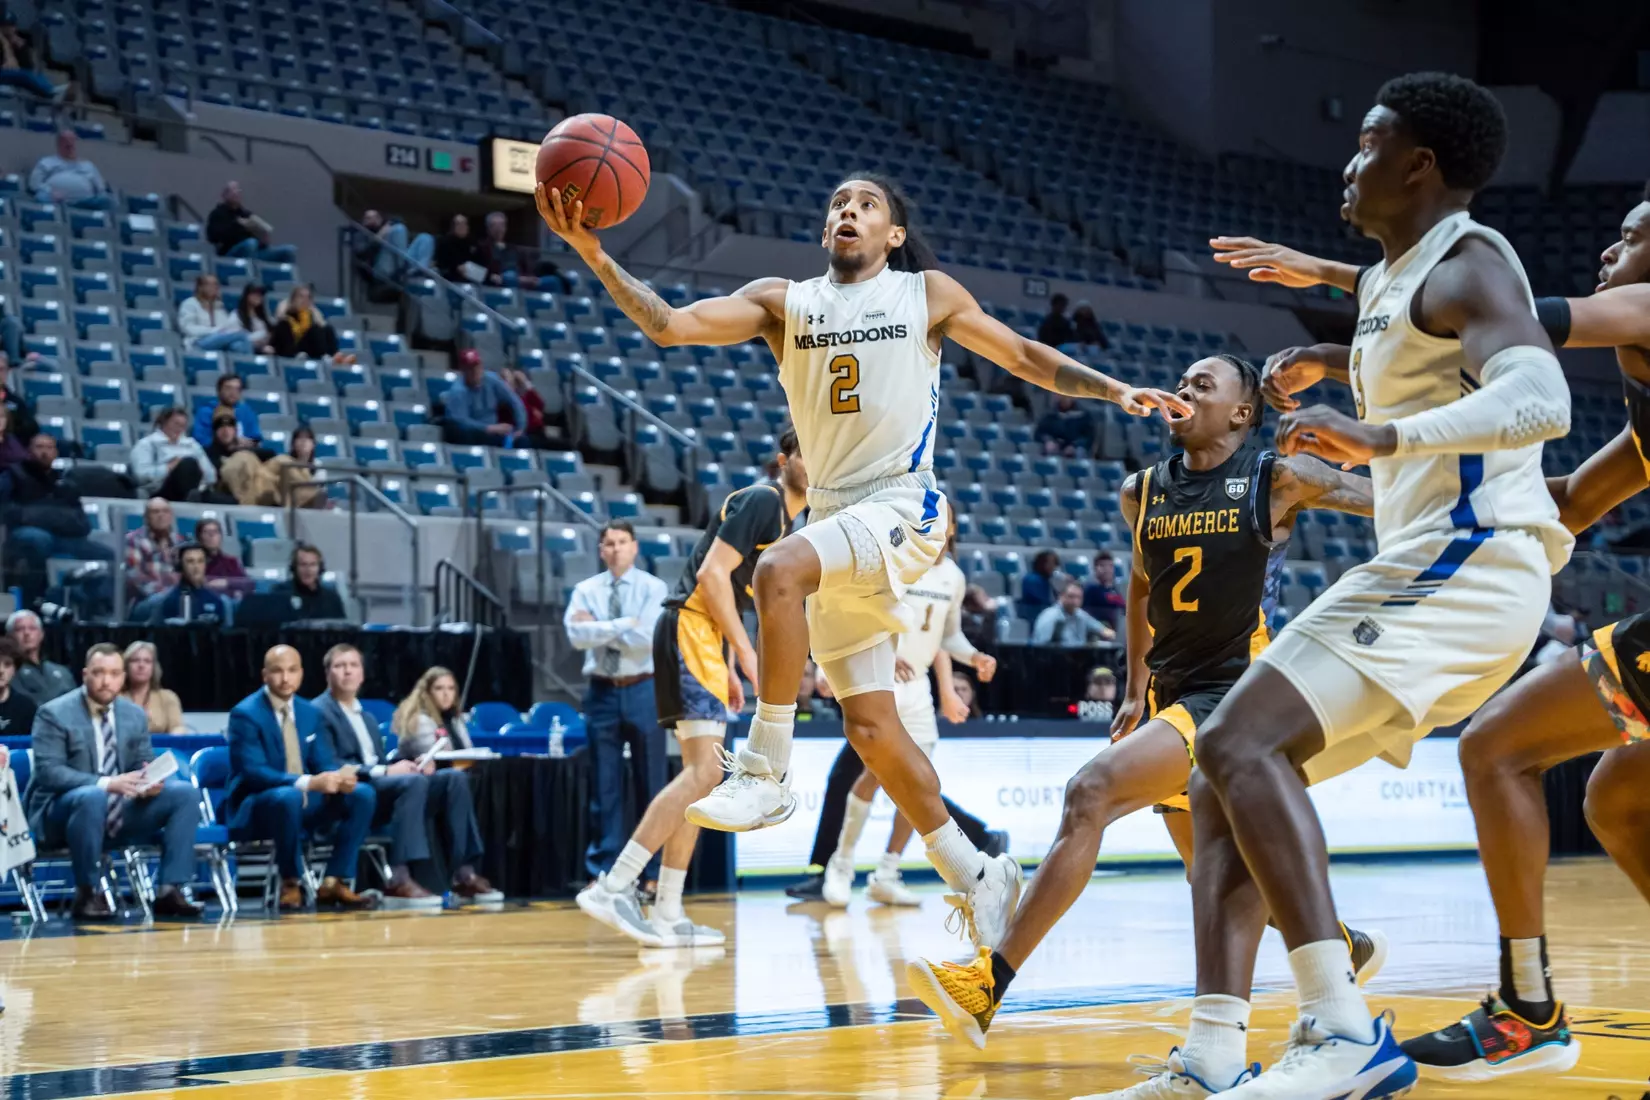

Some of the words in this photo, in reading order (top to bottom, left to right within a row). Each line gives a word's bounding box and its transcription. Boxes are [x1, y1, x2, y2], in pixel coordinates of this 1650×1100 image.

[390, 147, 416, 165] 214
[795, 325, 907, 349] MASTODONS
[830, 354, 861, 414] 2
[1228, 484, 1245, 493] 60
[1147, 508, 1240, 540] COMMERCE
[1171, 546, 1203, 612] 2
[920, 602, 934, 632] 1
[1078, 700, 1113, 719] POSS
